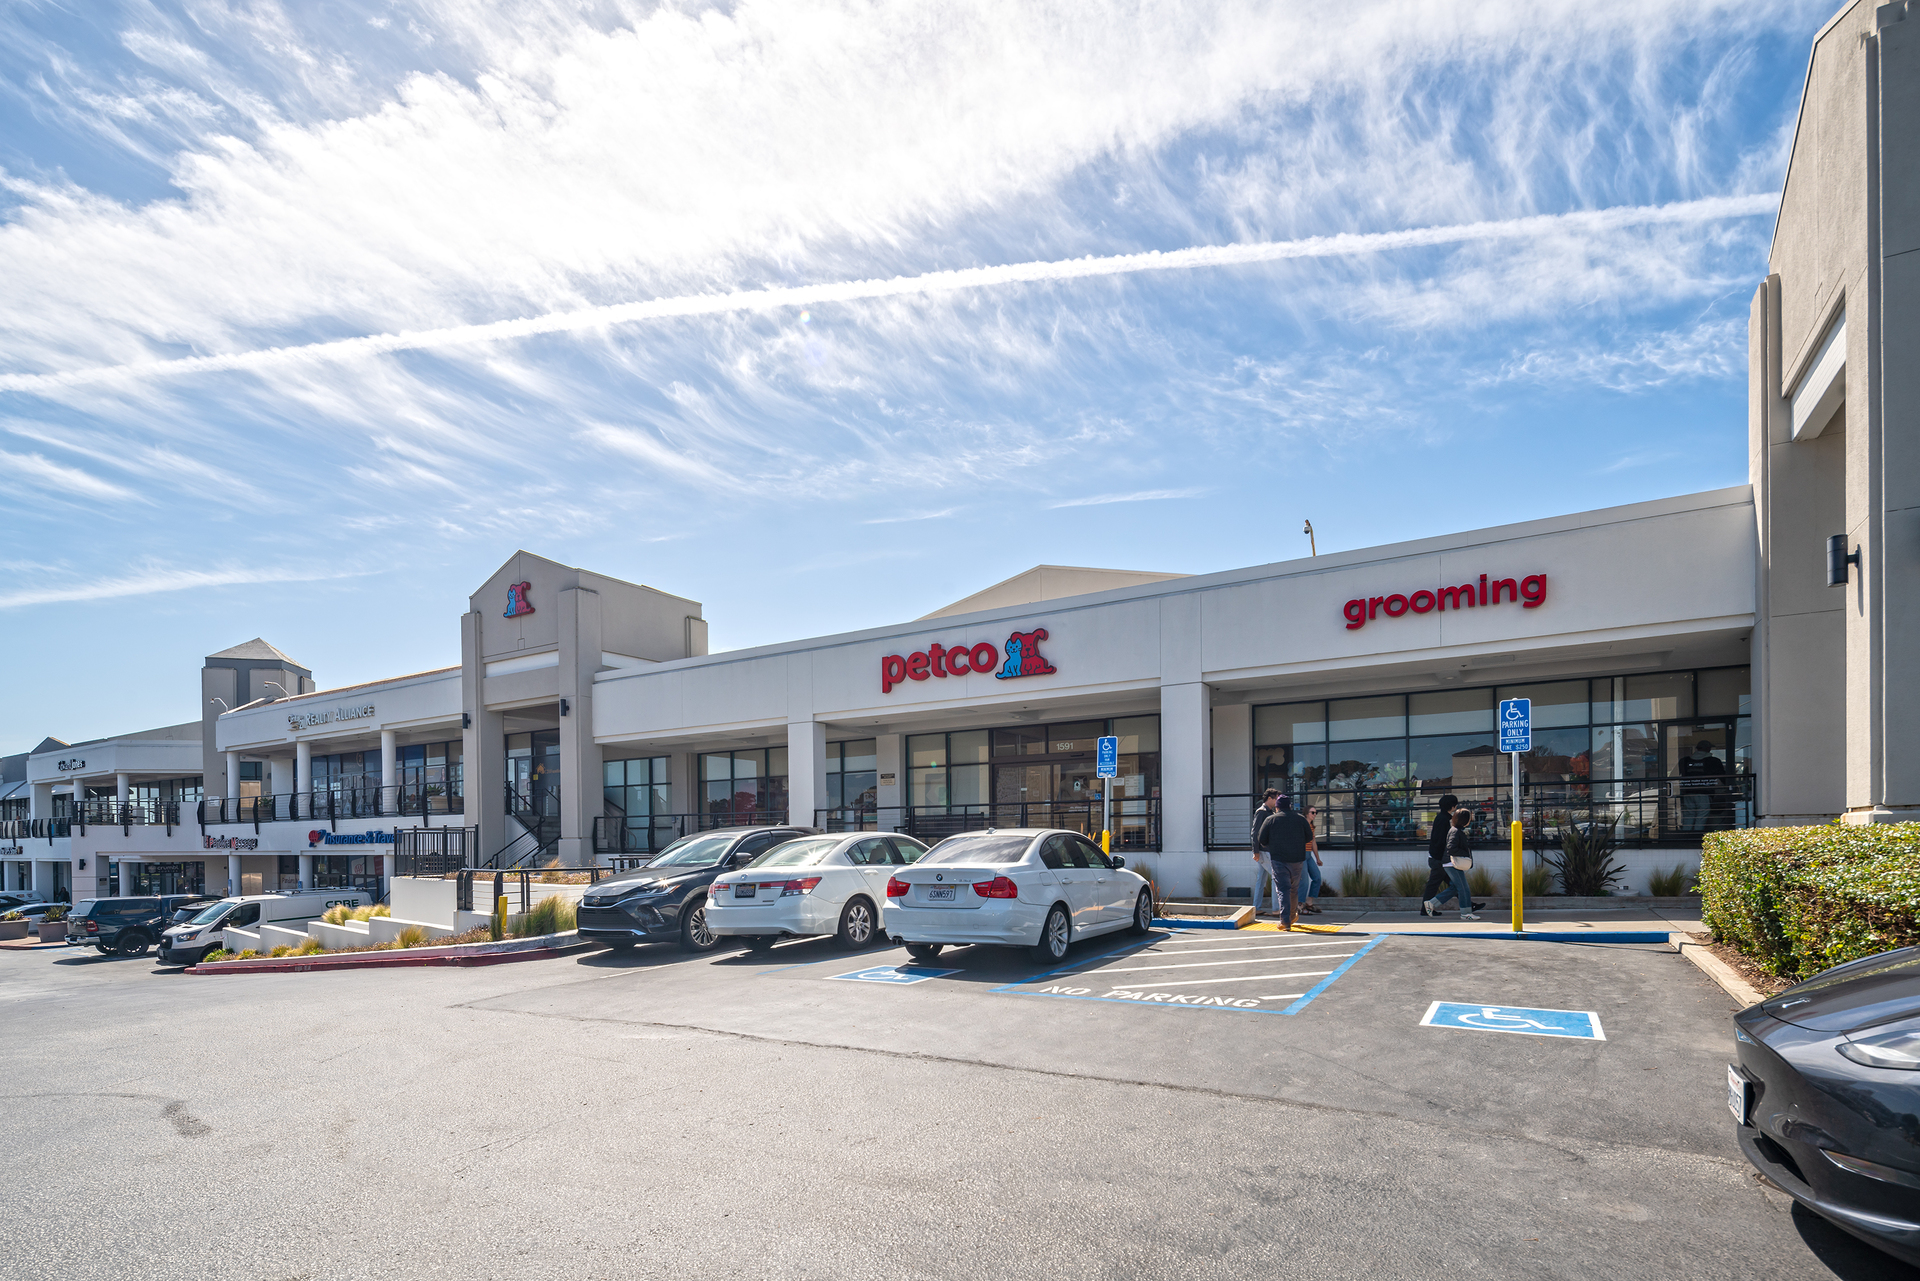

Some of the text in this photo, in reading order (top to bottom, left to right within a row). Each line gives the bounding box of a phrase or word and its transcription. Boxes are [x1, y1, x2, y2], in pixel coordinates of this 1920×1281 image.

[1343, 573, 1547, 630] grooming
[881, 643, 998, 694] petco
[305, 712, 333, 726] REALTY
[335, 705, 375, 721] ALLIANCE
[1501, 719, 1529, 729] PARKING
[1506, 728, 1524, 737] ONLY
[1056, 742, 1074, 751] 1591
[1515, 743, 1529, 751] $250
[231, 837, 258, 850] Massage
[324, 832, 366, 845] Insurance
[364, 831, 375, 844] &
[1039, 985, 1261, 1008] NO PARKING
